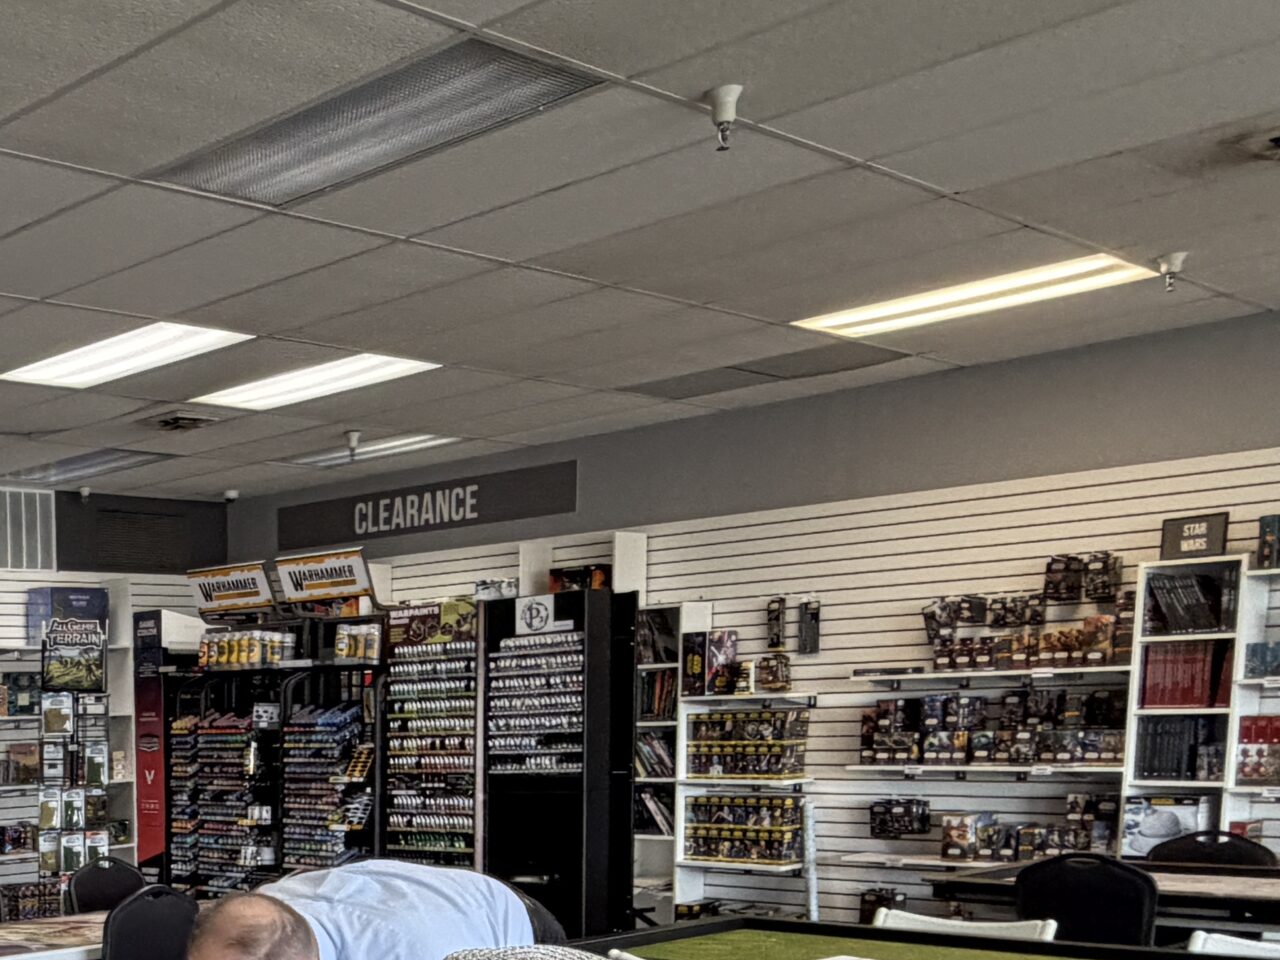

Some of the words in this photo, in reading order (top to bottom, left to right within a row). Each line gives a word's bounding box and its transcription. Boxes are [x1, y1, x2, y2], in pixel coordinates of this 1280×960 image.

[355, 485, 478, 534] CLEARANCE
[1183, 522, 1207, 536] STAR
[1181, 538, 1207, 552] WARS
[288, 564, 355, 592] WARHAMMER
[198, 577, 258, 602] WARHAMMER
[47, 633, 100, 646] TERRAIN
